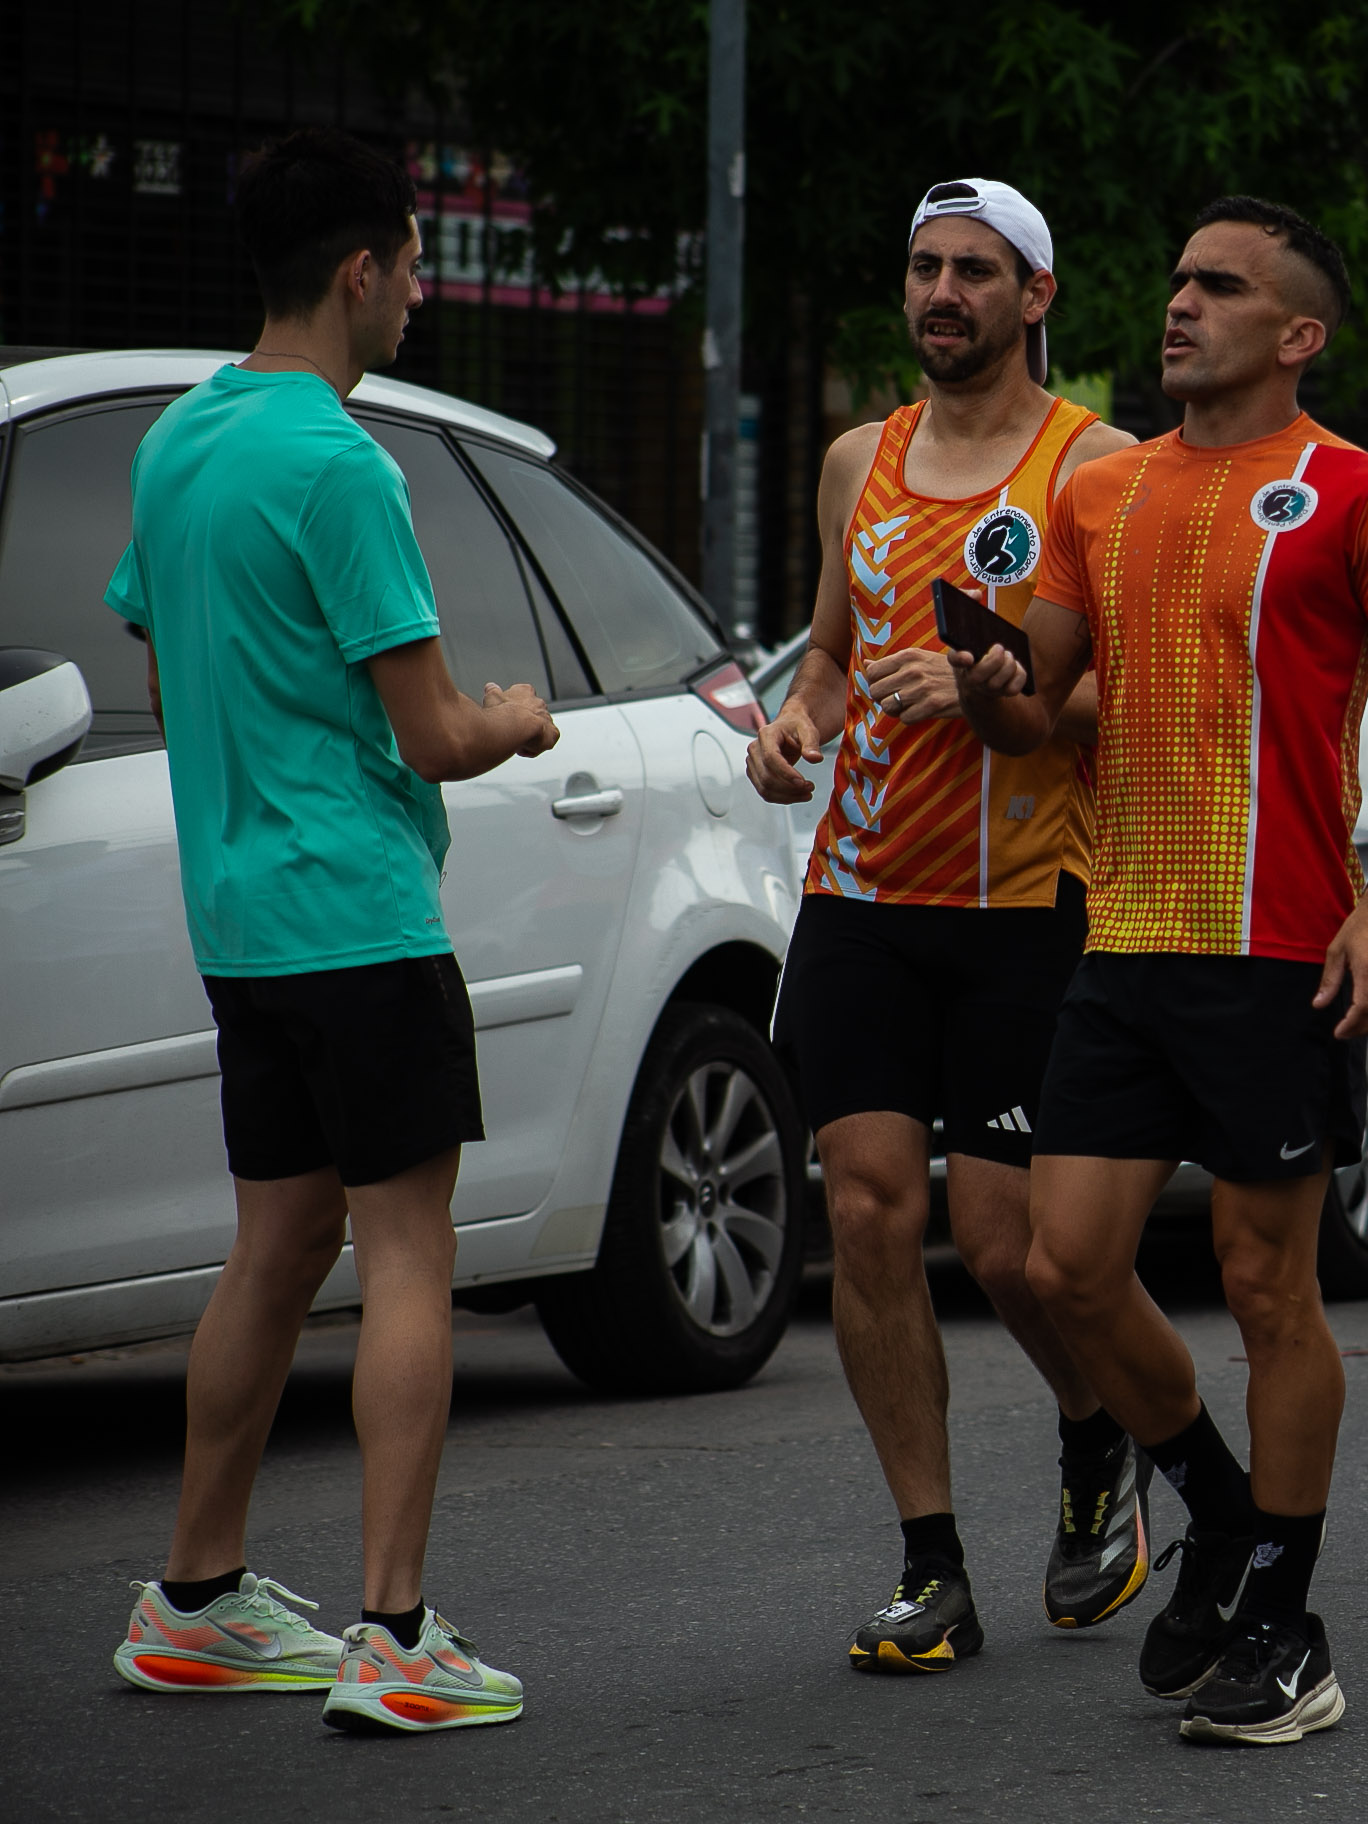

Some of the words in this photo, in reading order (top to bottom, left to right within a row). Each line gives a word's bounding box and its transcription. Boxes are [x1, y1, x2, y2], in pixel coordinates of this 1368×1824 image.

[972, 526, 983, 539] de
[983, 508, 1037, 547] Entrenamiento
[968, 541, 982, 575] Grupo
[1014, 551, 1037, 580] Daniel
[981, 573, 1012, 584] Penta
